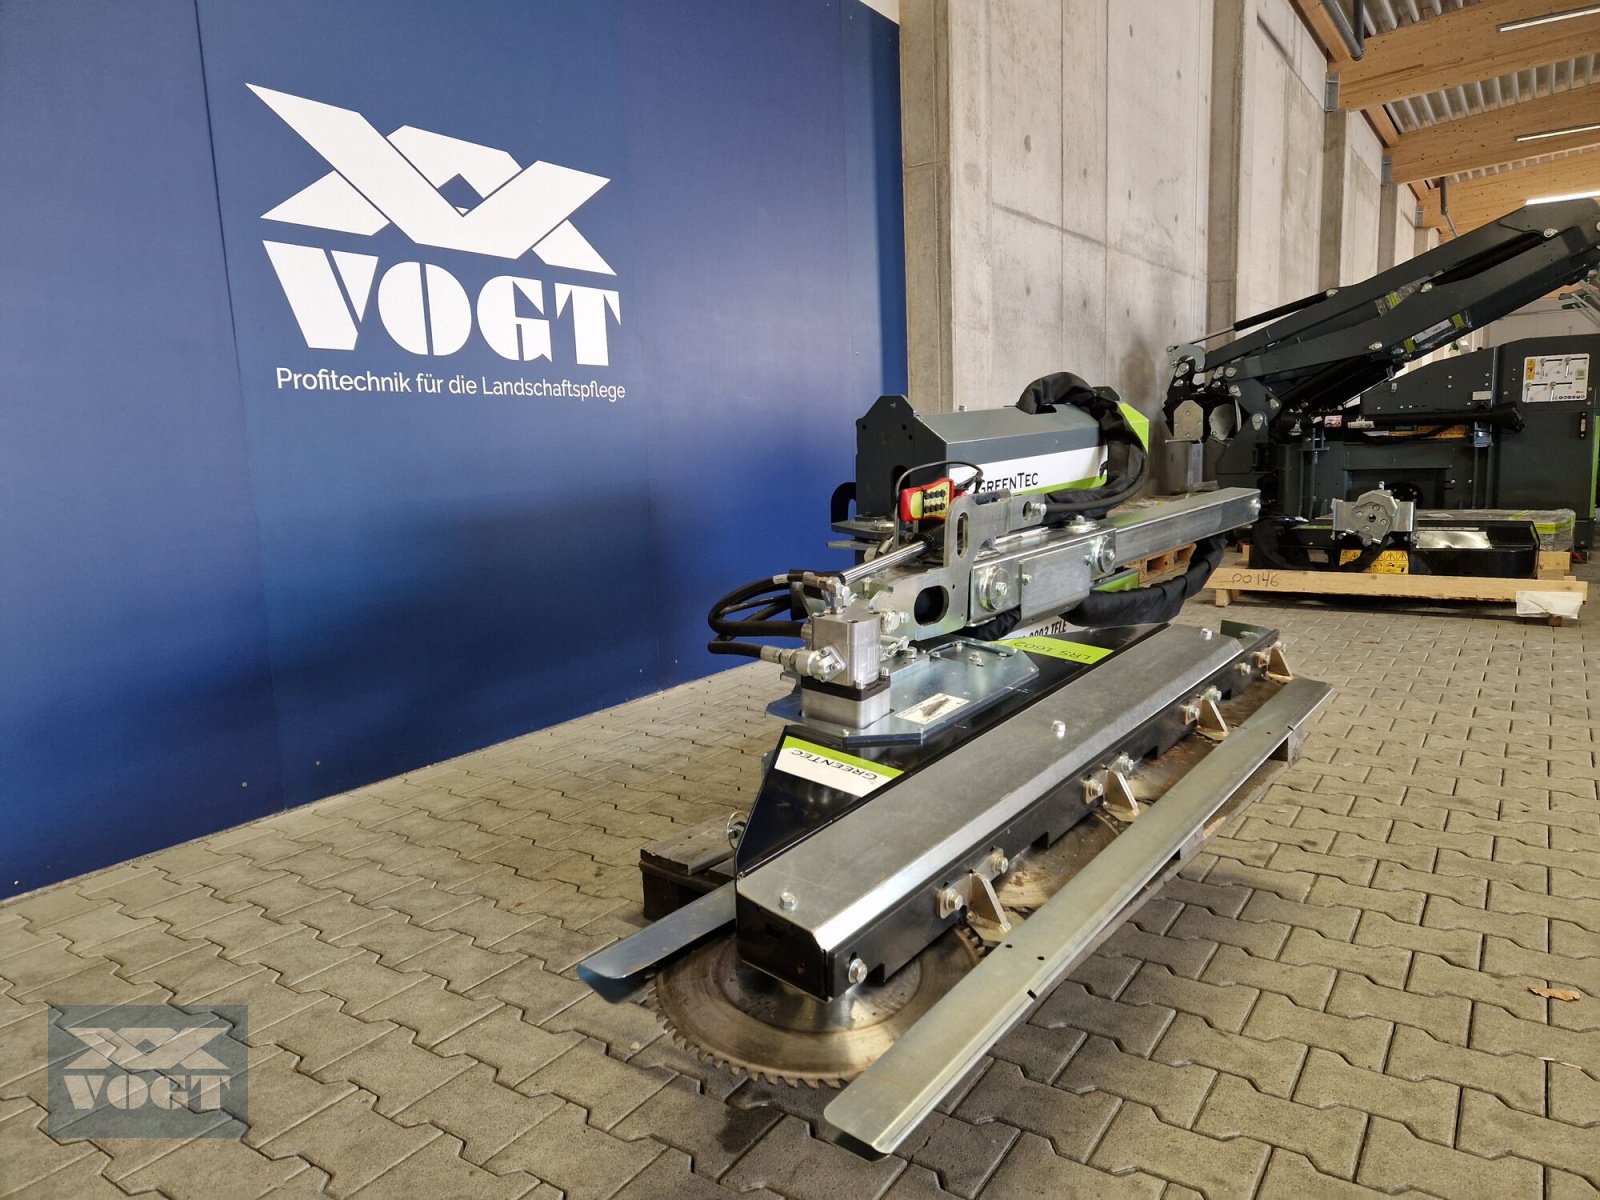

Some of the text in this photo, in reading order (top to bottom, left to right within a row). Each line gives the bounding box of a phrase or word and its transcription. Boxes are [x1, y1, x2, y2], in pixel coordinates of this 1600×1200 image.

[262, 240, 621, 366] VOGT
[276, 367, 626, 403] Profitechnik für die Landschaftspflege
[1058, 650, 1092, 661] LRS
